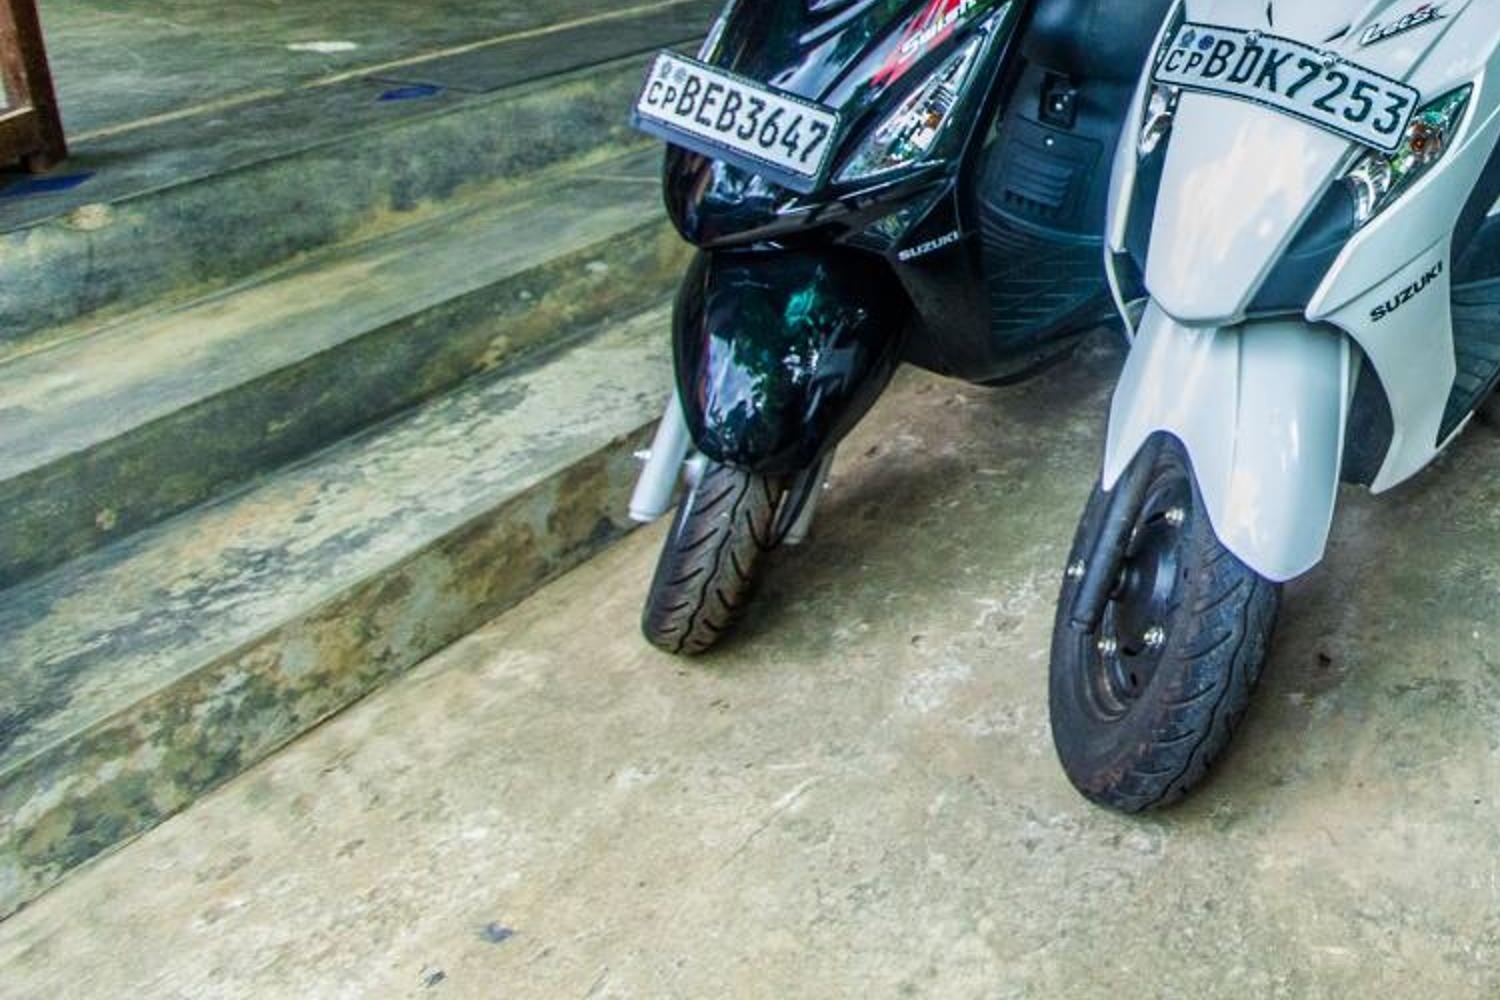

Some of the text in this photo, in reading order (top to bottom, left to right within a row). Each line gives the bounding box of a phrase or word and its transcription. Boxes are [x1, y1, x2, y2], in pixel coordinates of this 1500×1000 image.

[647, 74, 829, 163] CP BEB3647
[1165, 39, 1402, 135] CP BDK7253
[898, 230, 960, 261] SUZUKI
[1369, 259, 1443, 323] SUZUKI
